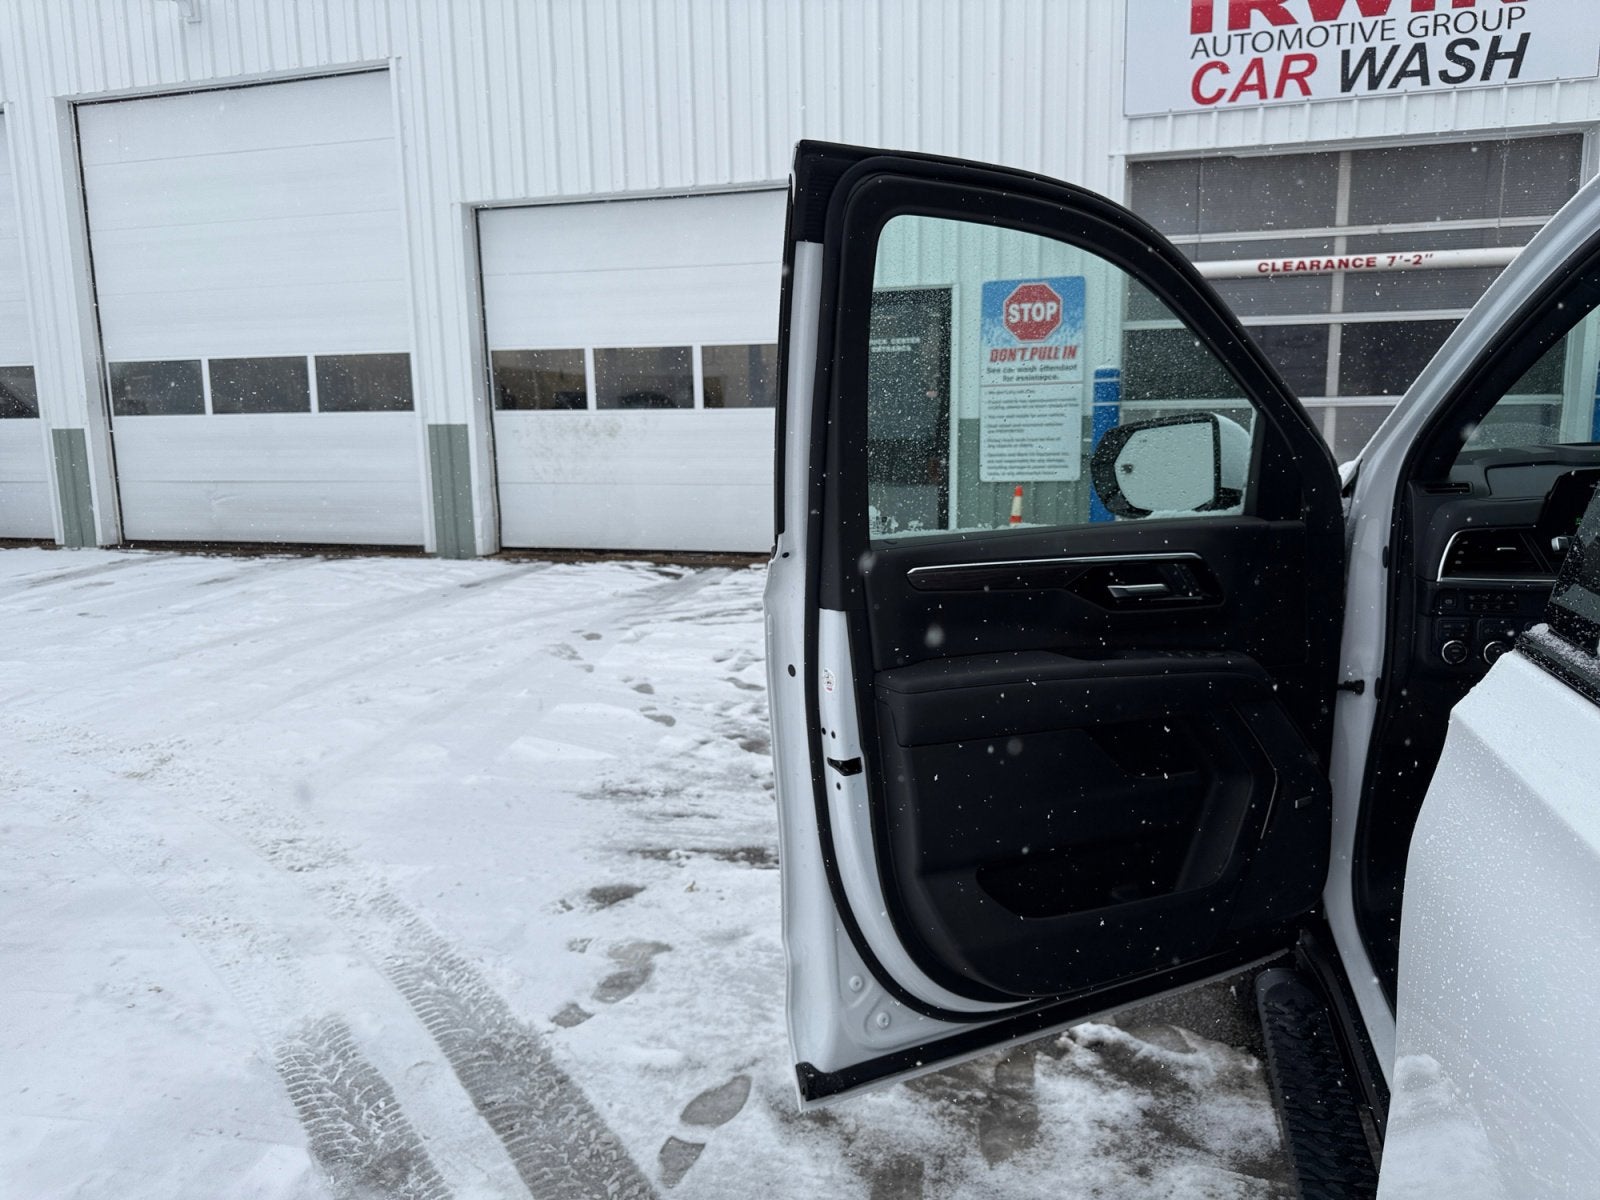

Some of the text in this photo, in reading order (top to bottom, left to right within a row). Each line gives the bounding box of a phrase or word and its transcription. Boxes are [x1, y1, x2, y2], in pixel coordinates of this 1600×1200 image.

[1190, 18, 1396, 60] AUTOMOTIVE
[1407, 6, 1526, 39] GROUP
[1191, 32, 1531, 106] CAR WASH
[1257, 256, 1377, 274] CLEARANCE
[1007, 302, 1058, 324] STOP
[989, 345, 1078, 363] DON'T PULL IN
